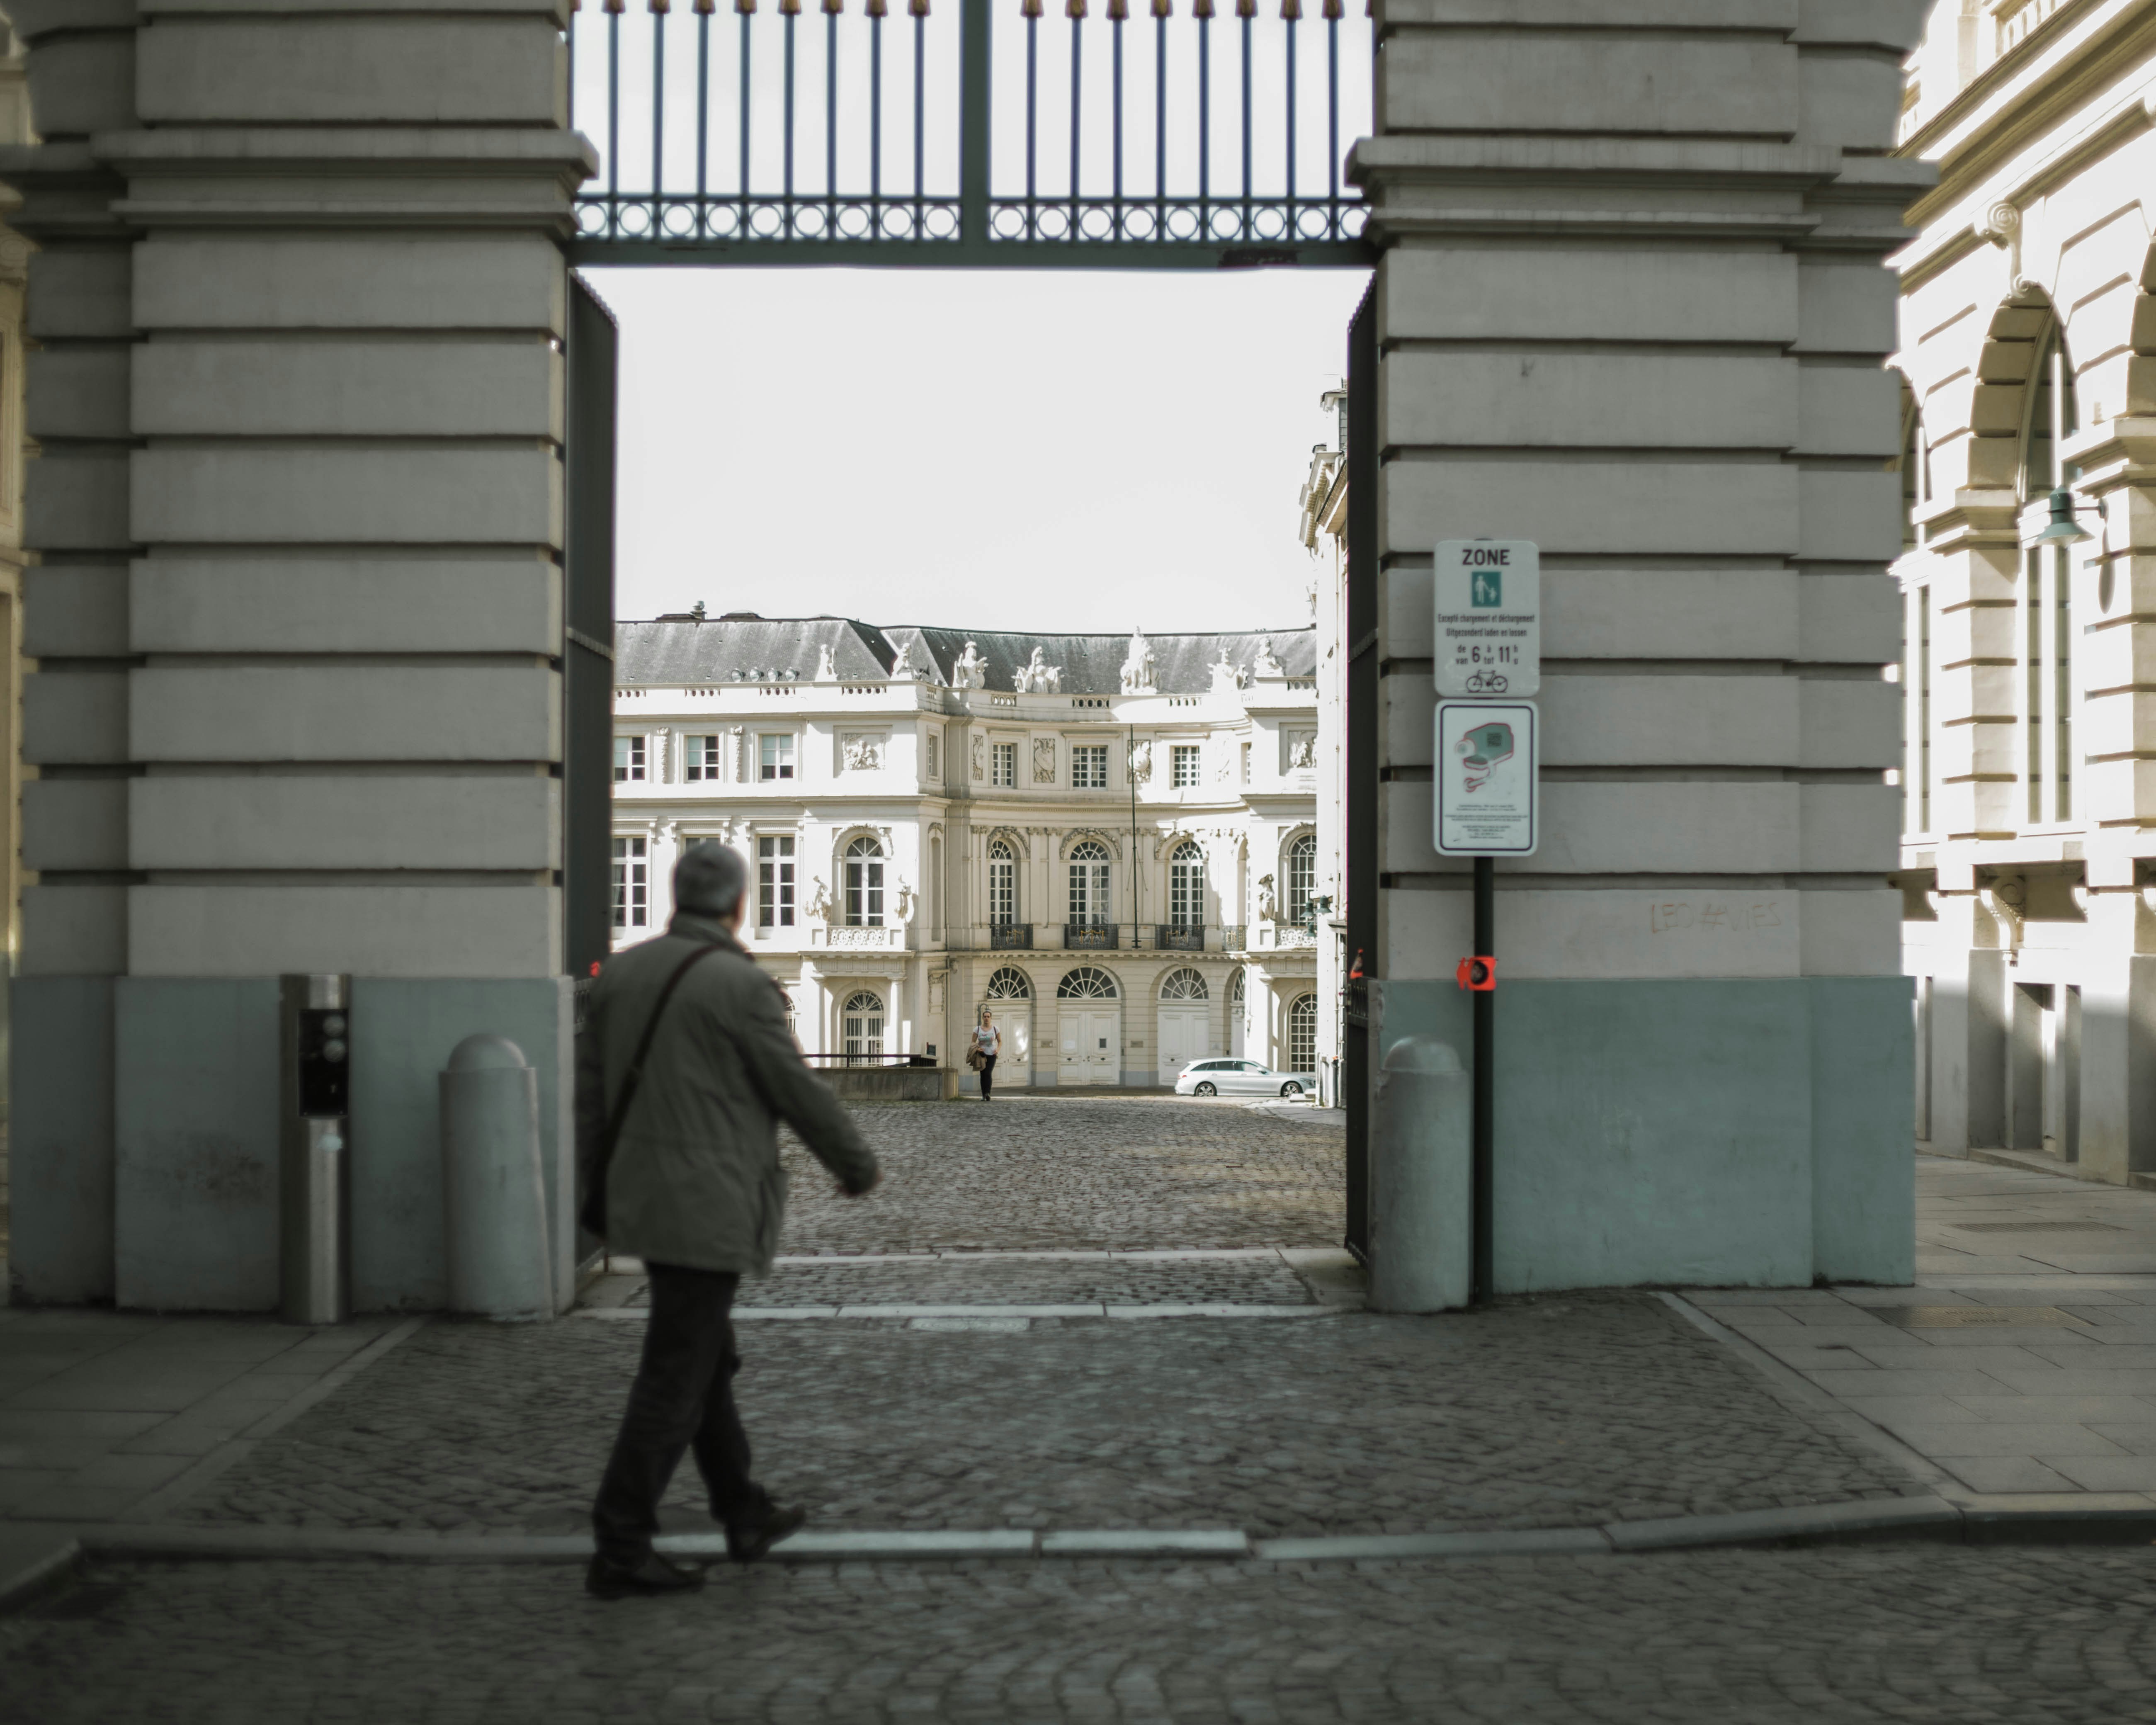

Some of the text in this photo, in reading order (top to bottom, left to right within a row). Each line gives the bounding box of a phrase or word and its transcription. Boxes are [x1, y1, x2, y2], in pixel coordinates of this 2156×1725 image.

[1462, 549, 1510, 566] ZONE
[1438, 613, 1535, 625] Excepté chargement et déchargement
[1446, 627, 1483, 639] Uitgezonderd
[1484, 627, 1499, 637] laden
[1509, 627, 1527, 637] lossen
[1457, 644, 1466, 653] de
[1472, 646, 1481, 663] 6
[1499, 645, 1510, 663] 11
[1513, 644, 1518, 653] h
[1484, 656, 1494, 664] tot
